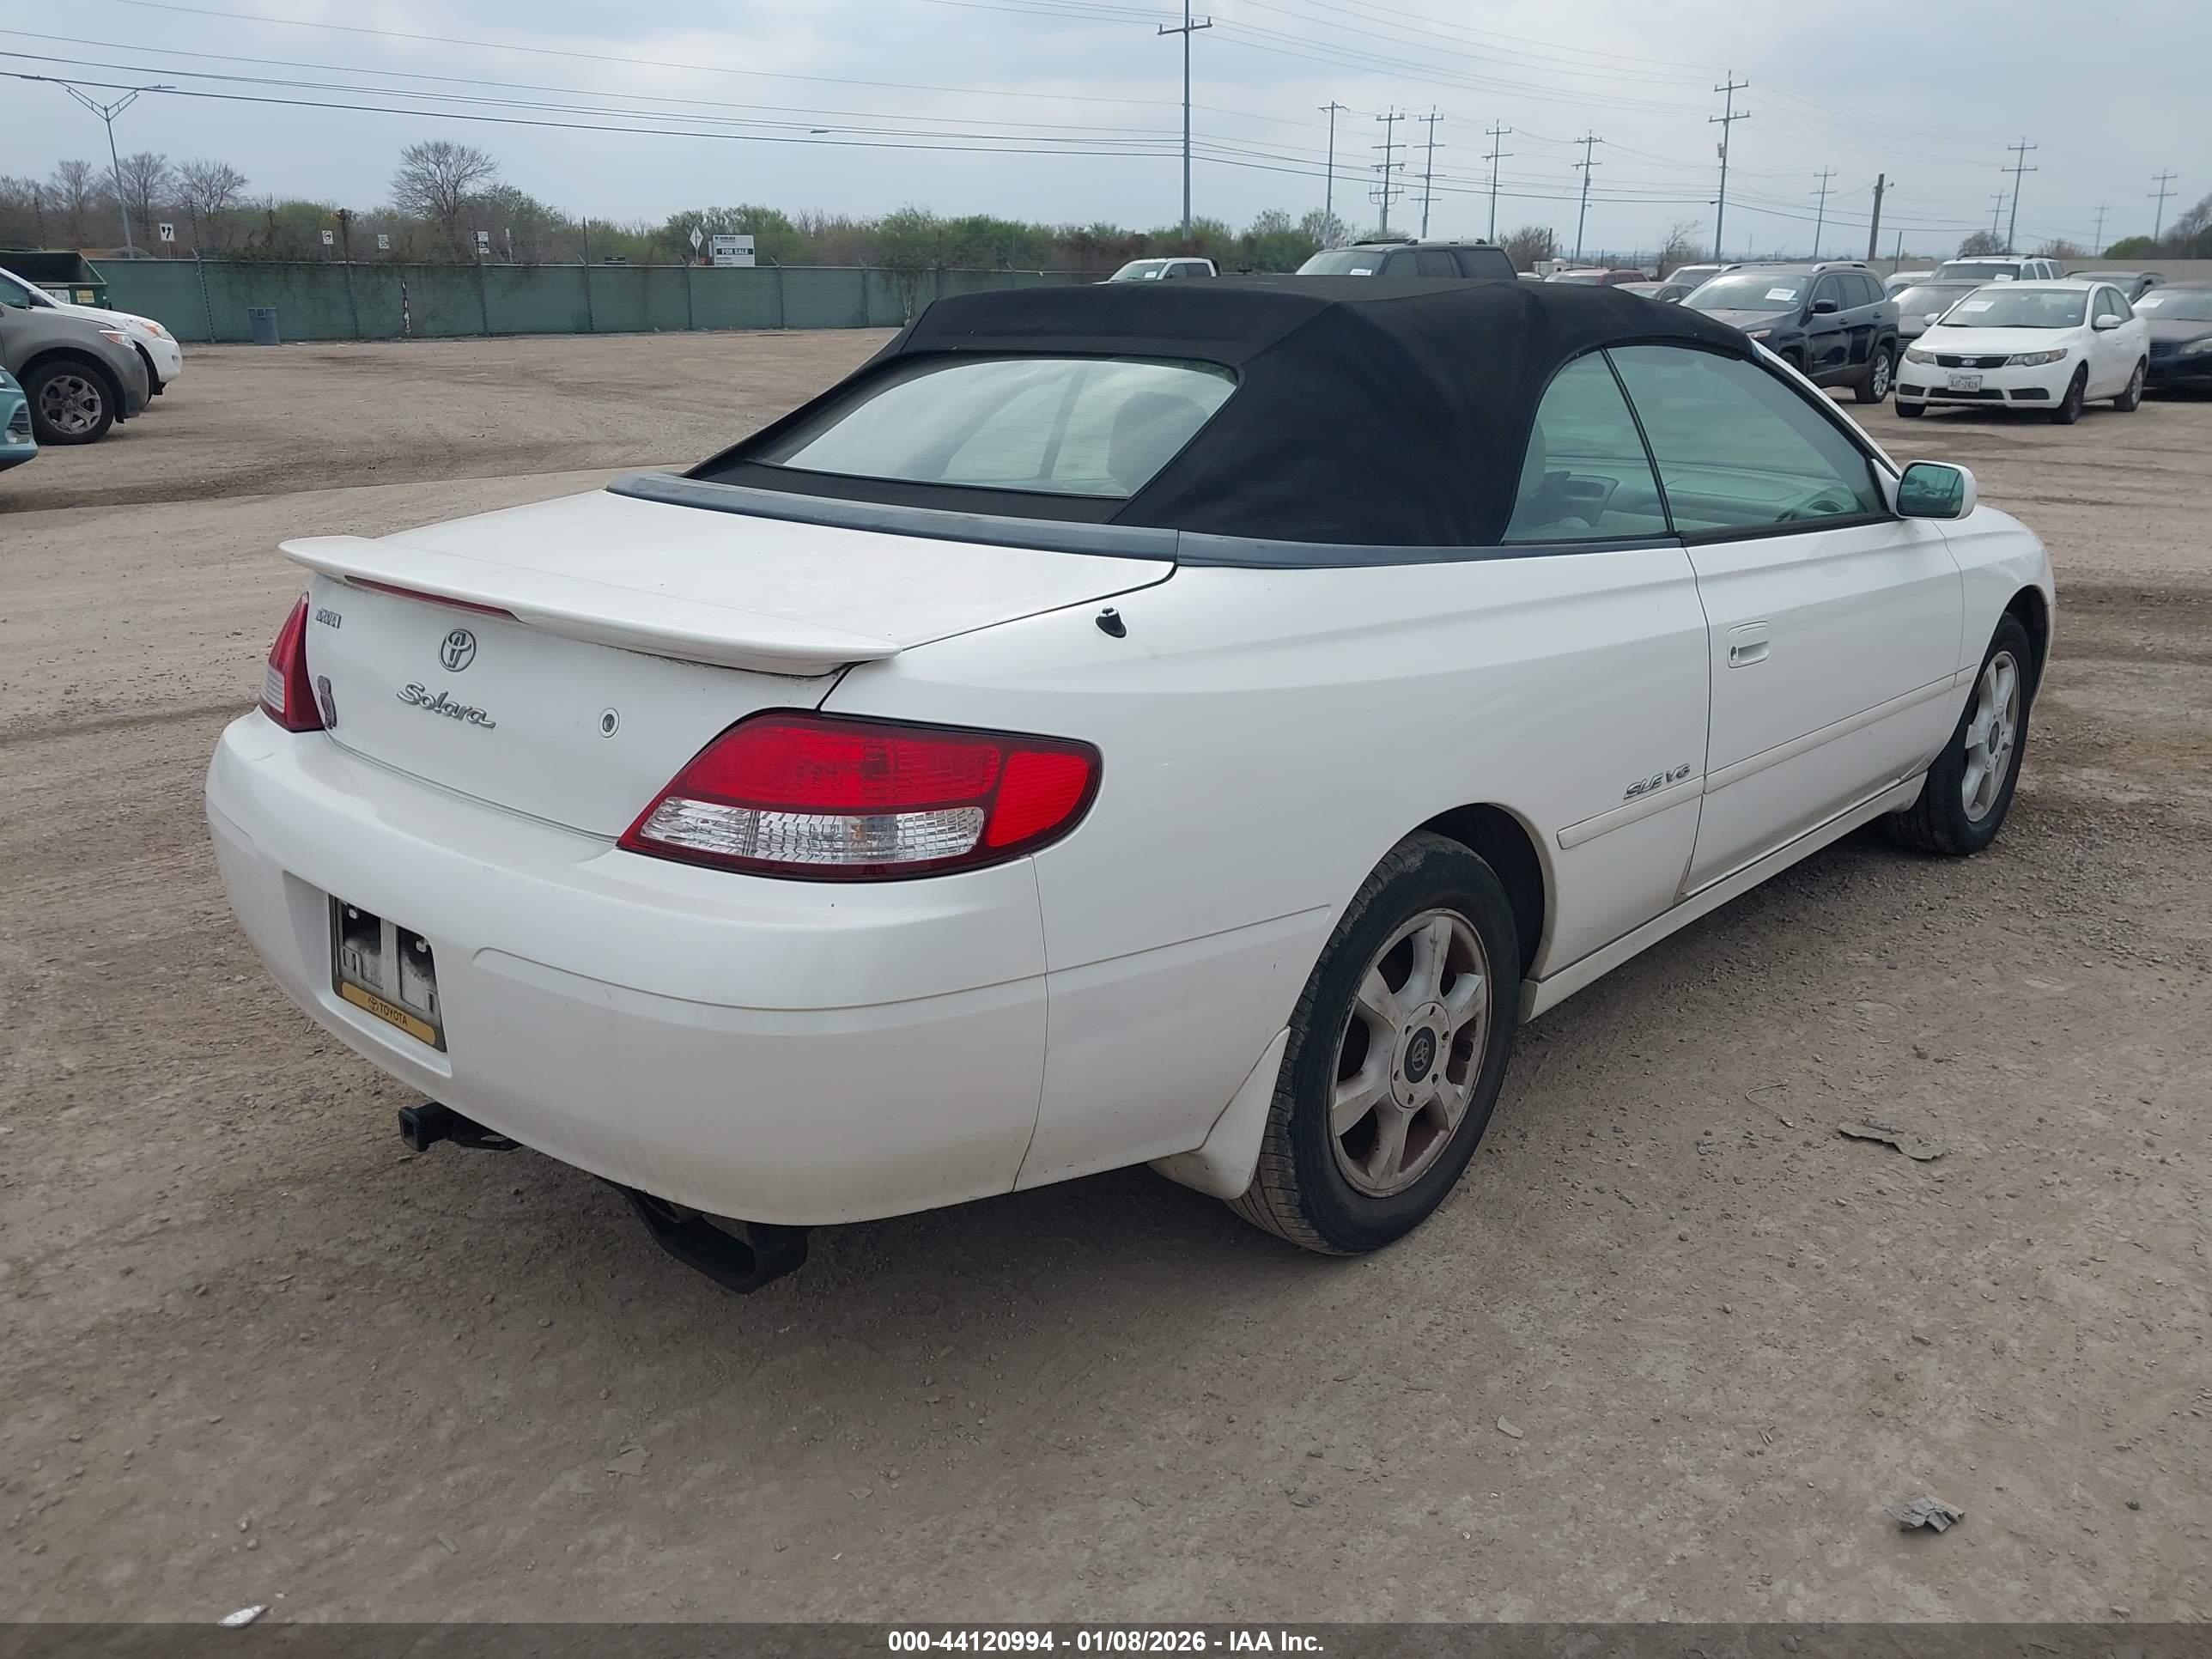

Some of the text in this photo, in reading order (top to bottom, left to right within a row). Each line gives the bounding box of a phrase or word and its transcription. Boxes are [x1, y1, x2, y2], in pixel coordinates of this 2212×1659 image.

[397, 682, 496, 728] Solara
[1623, 763, 1691, 800] SLE V6
[379, 1003, 408, 1026] TOYOTA
